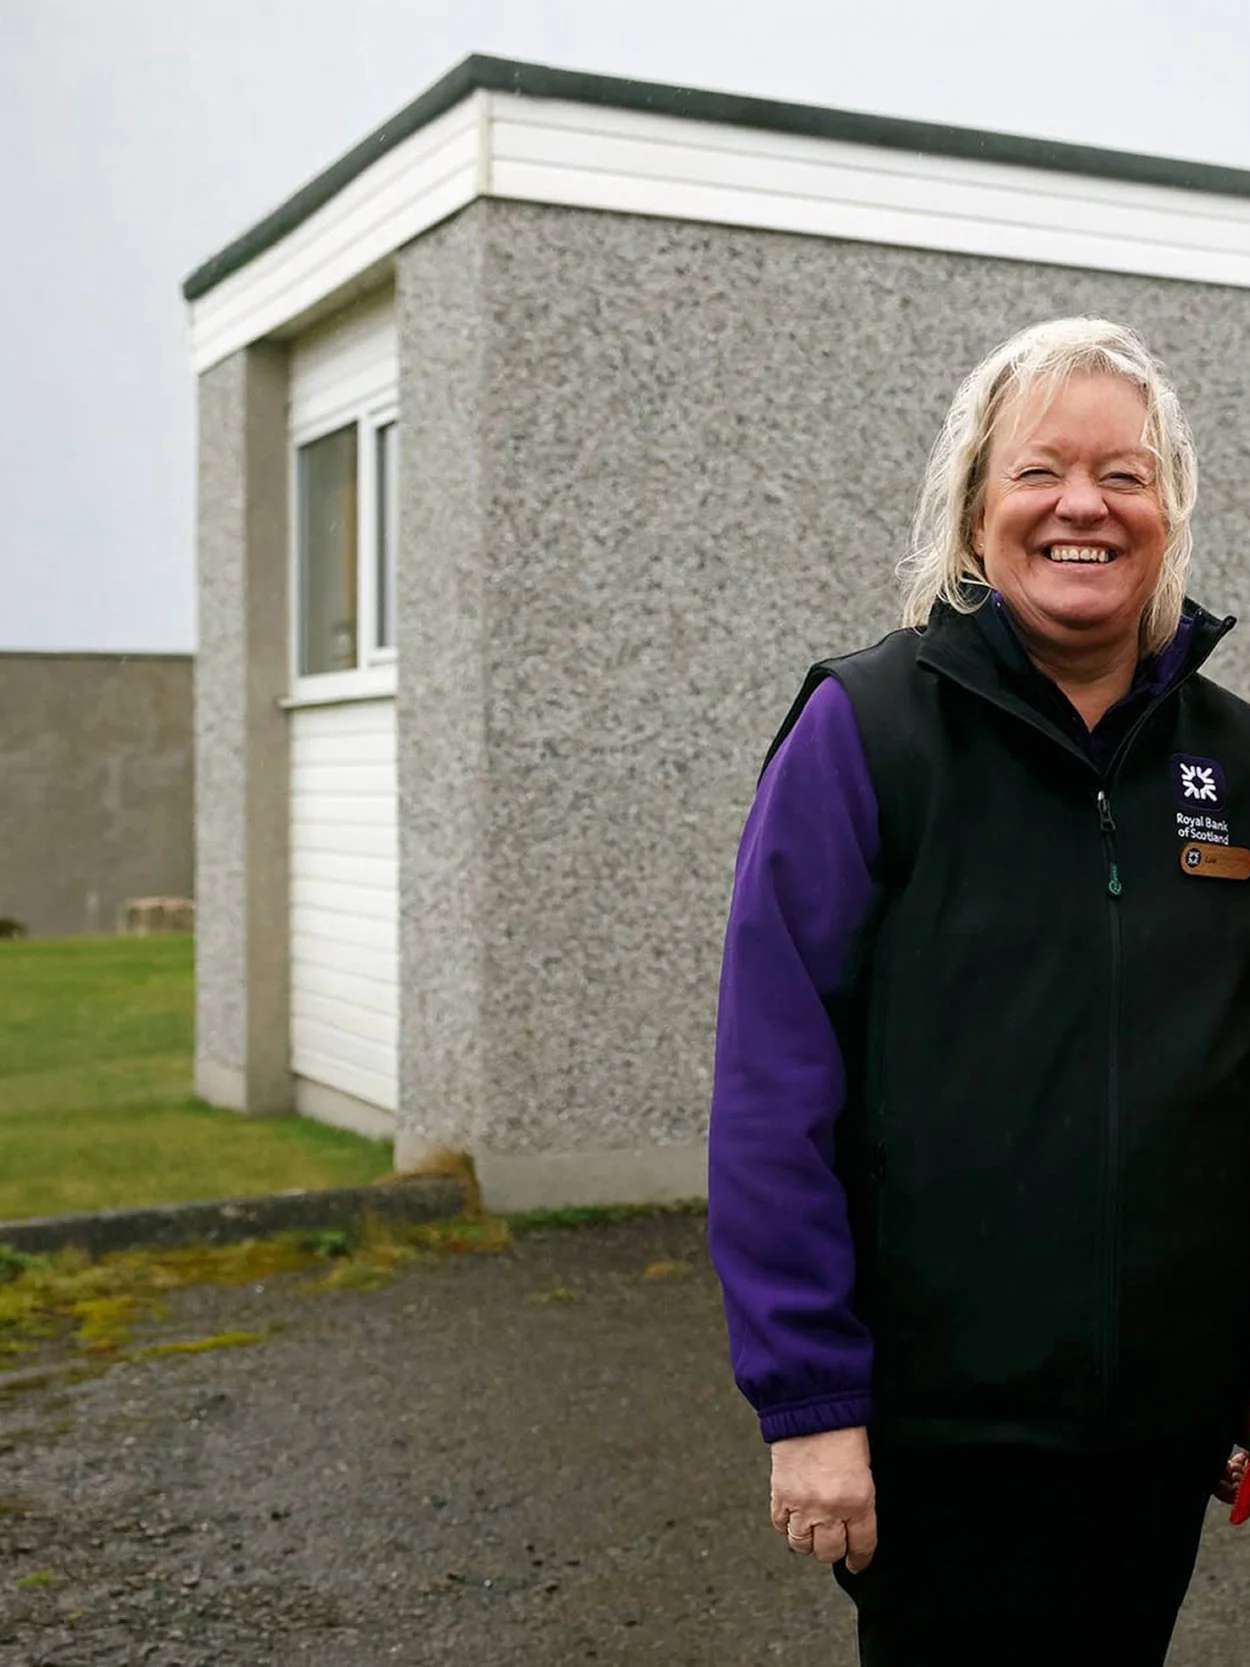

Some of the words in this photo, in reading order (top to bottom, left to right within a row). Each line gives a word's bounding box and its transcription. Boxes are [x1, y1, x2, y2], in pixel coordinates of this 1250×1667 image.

[1176, 812, 1204, 828] Royal
[1205, 816, 1229, 832] Bank
[1178, 826, 1190, 837] of
[1190, 828, 1229, 845] Scotland
